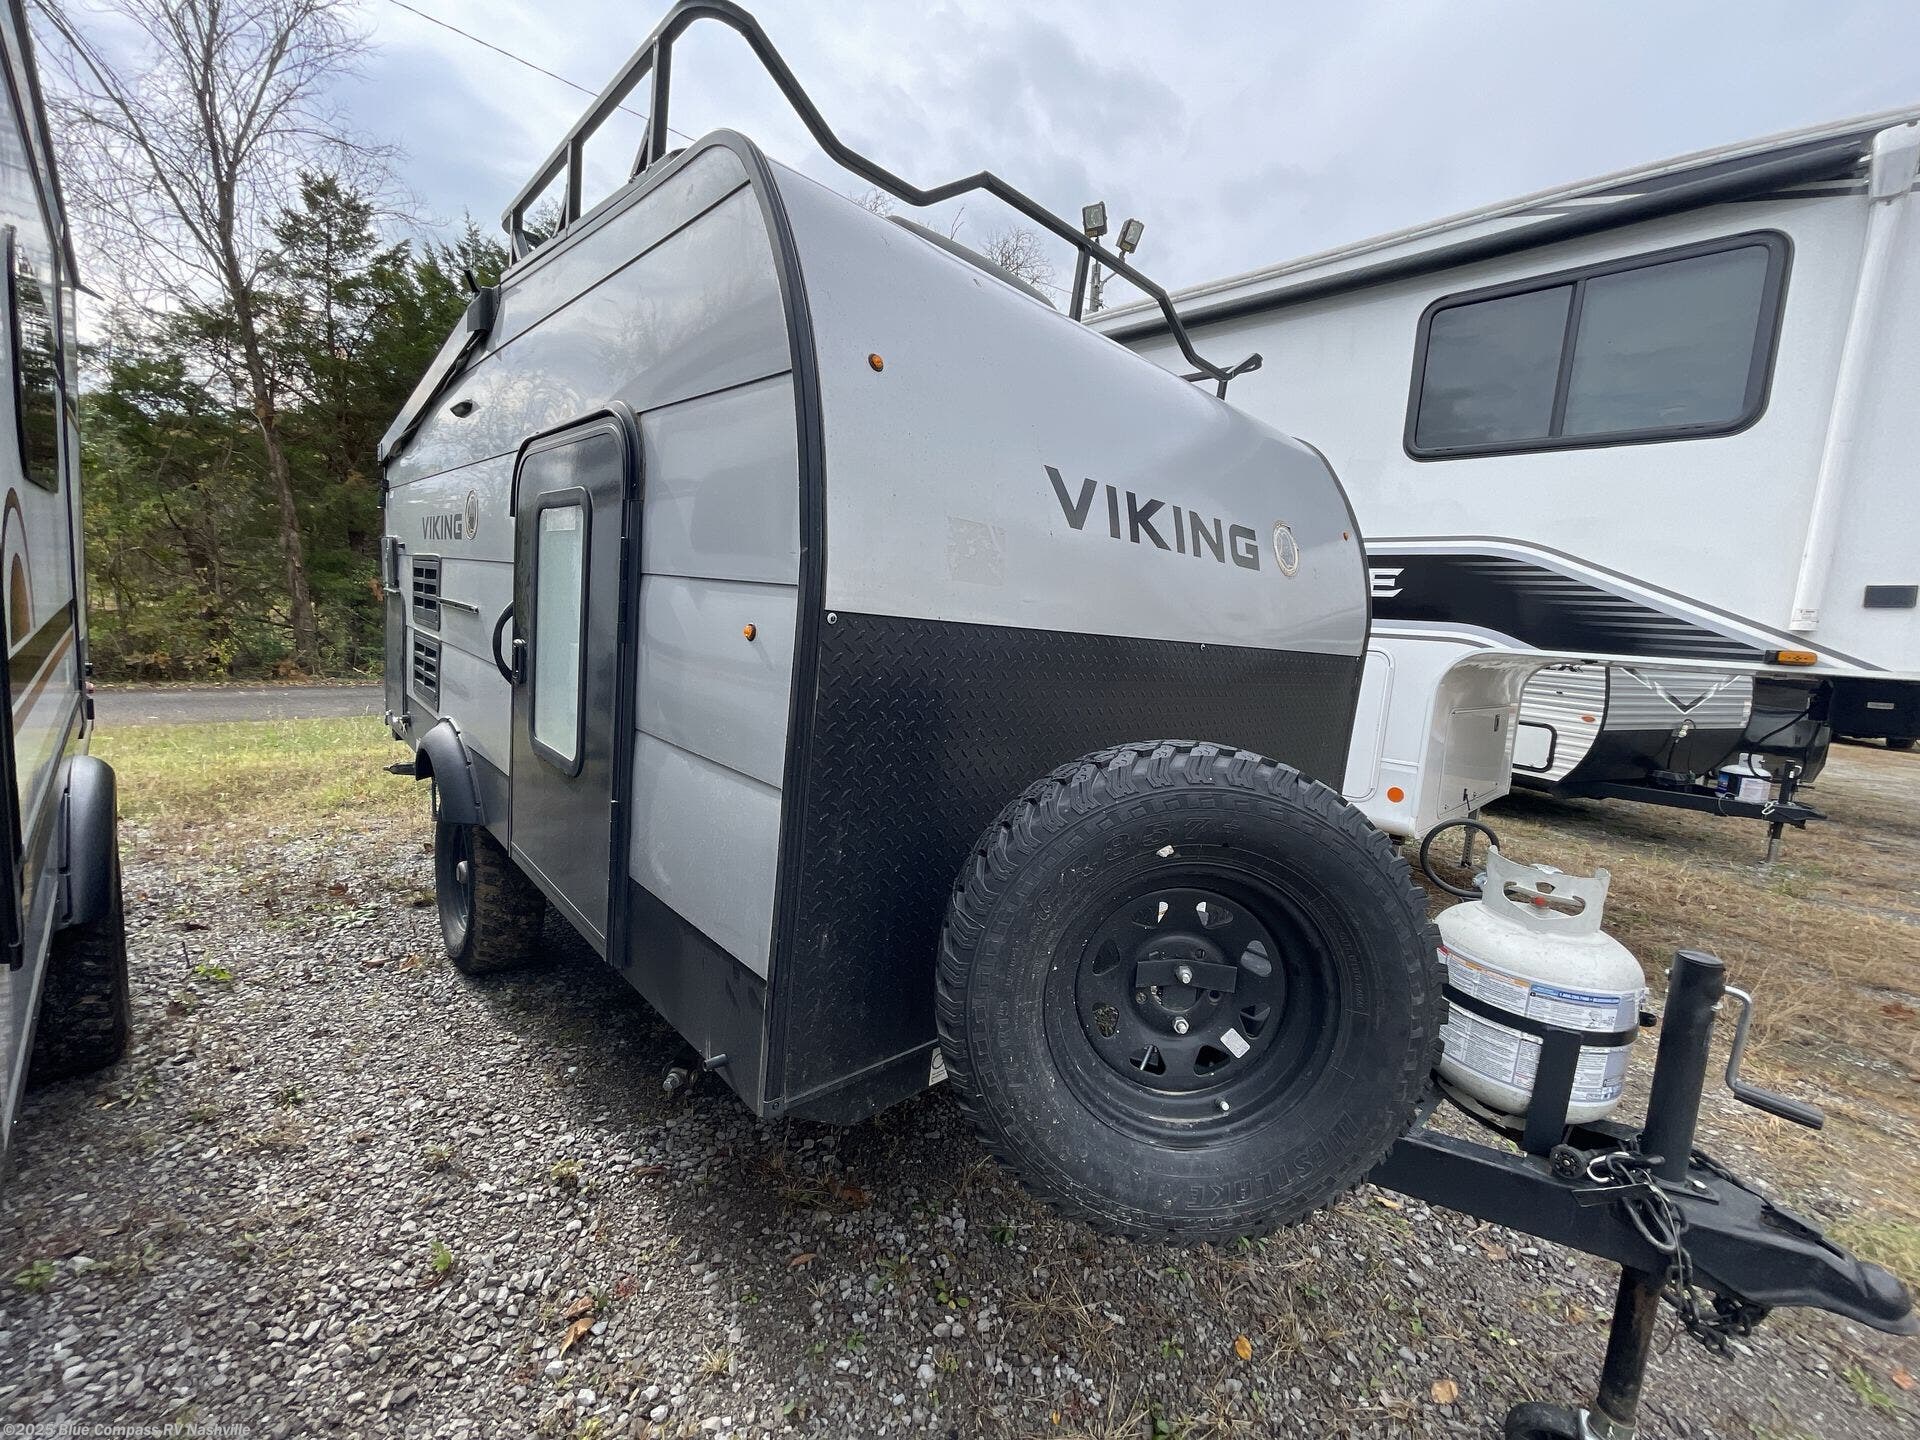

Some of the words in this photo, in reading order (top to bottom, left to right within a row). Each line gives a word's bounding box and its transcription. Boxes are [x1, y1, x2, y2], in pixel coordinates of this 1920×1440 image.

[422, 514, 462, 540] VIKING
[1044, 465, 1260, 571] VIKING
[1184, 1111, 1359, 1210] WESTLAKE
